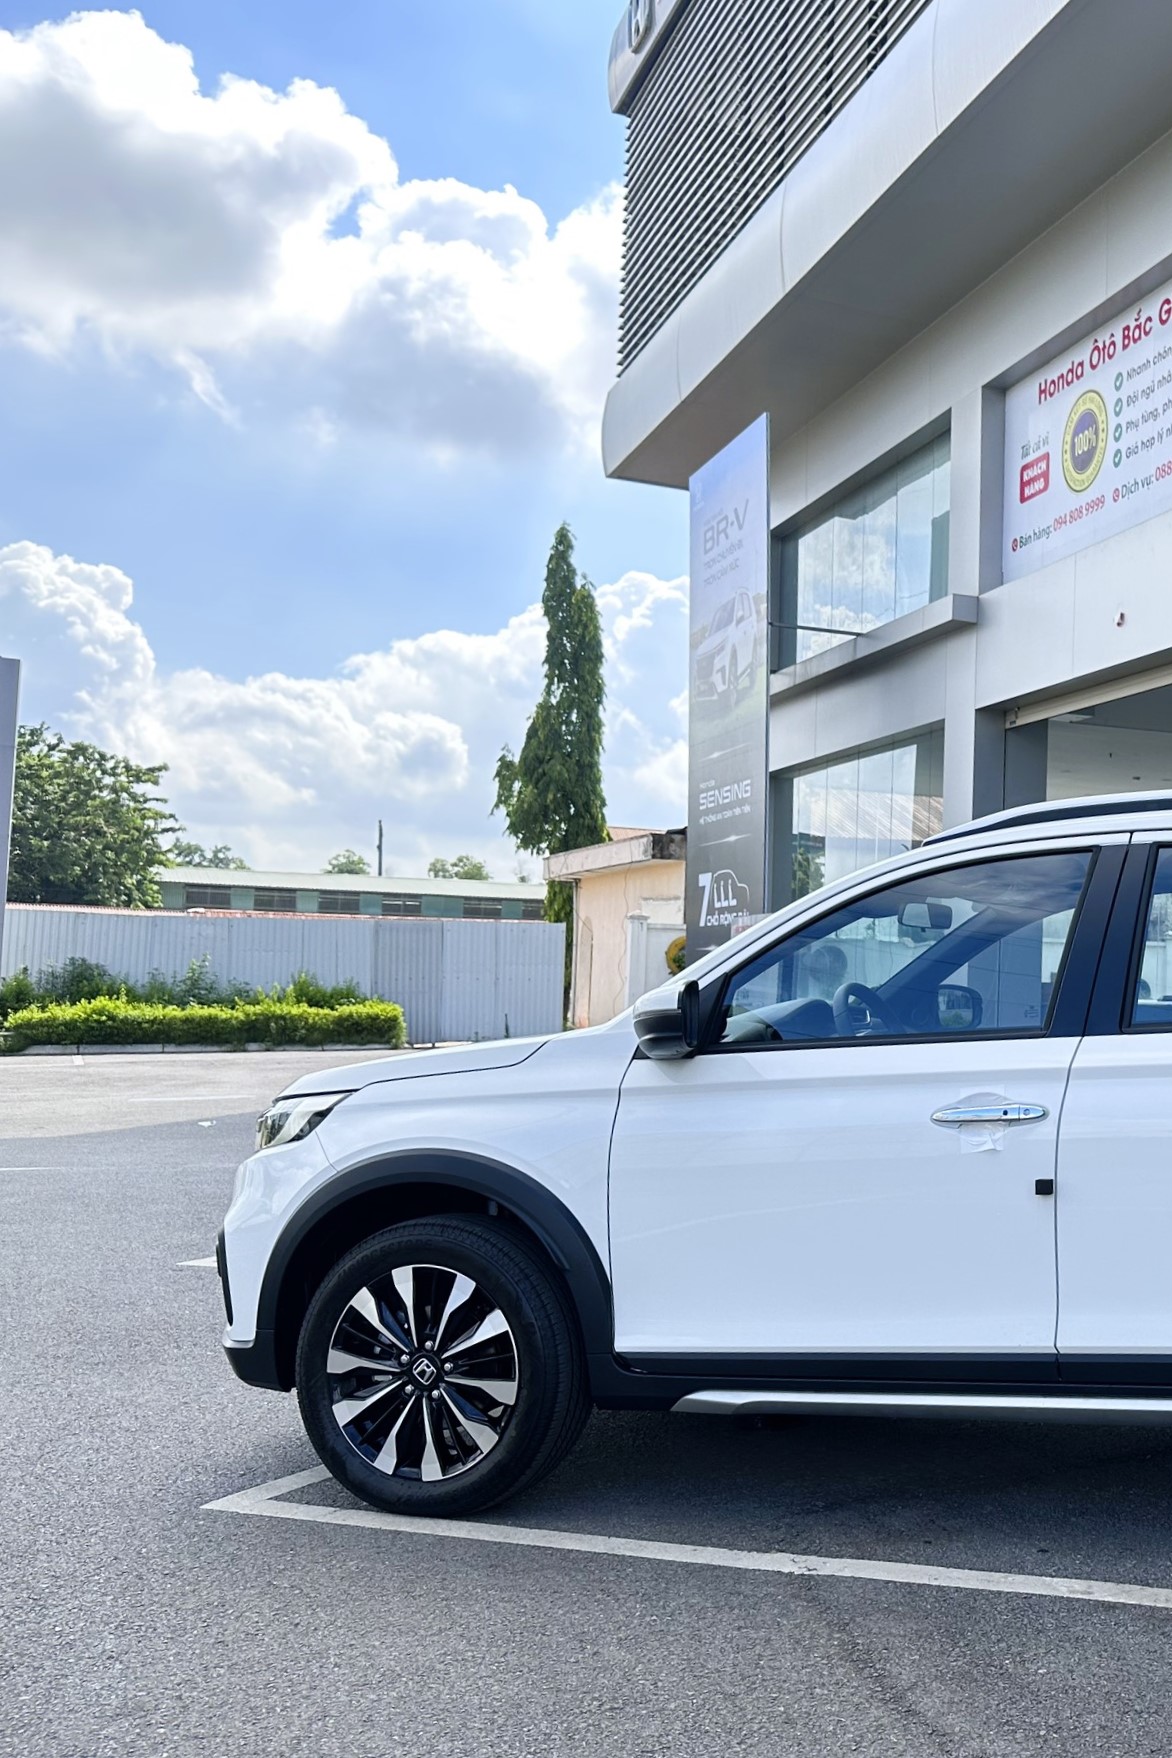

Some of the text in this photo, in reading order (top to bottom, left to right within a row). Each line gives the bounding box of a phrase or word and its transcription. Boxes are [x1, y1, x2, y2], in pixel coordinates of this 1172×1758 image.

[1037, 359, 1085, 405] Honda
[1088, 332, 1118, 372] Ôtô
[1121, 307, 1153, 352] Bắc
[1126, 358, 1152, 382] Nhanh
[1126, 389, 1140, 408] Đội
[1074, 423, 1097, 457] 100%
[1125, 416, 1140, 434] Phụ
[1125, 440, 1139, 459] Giá
[1156, 427, 1165, 445] lý
[1121, 476, 1140, 500] Dịch
[1140, 474, 1155, 493] vụ:
[1018, 532, 1033, 549] Bán
[1053, 512, 1068, 532] 094
[1068, 504, 1084, 525] 808
[1084, 493, 1106, 517] 9999
[699, 779, 752, 811] SENSING
[698, 871, 713, 928] 7
